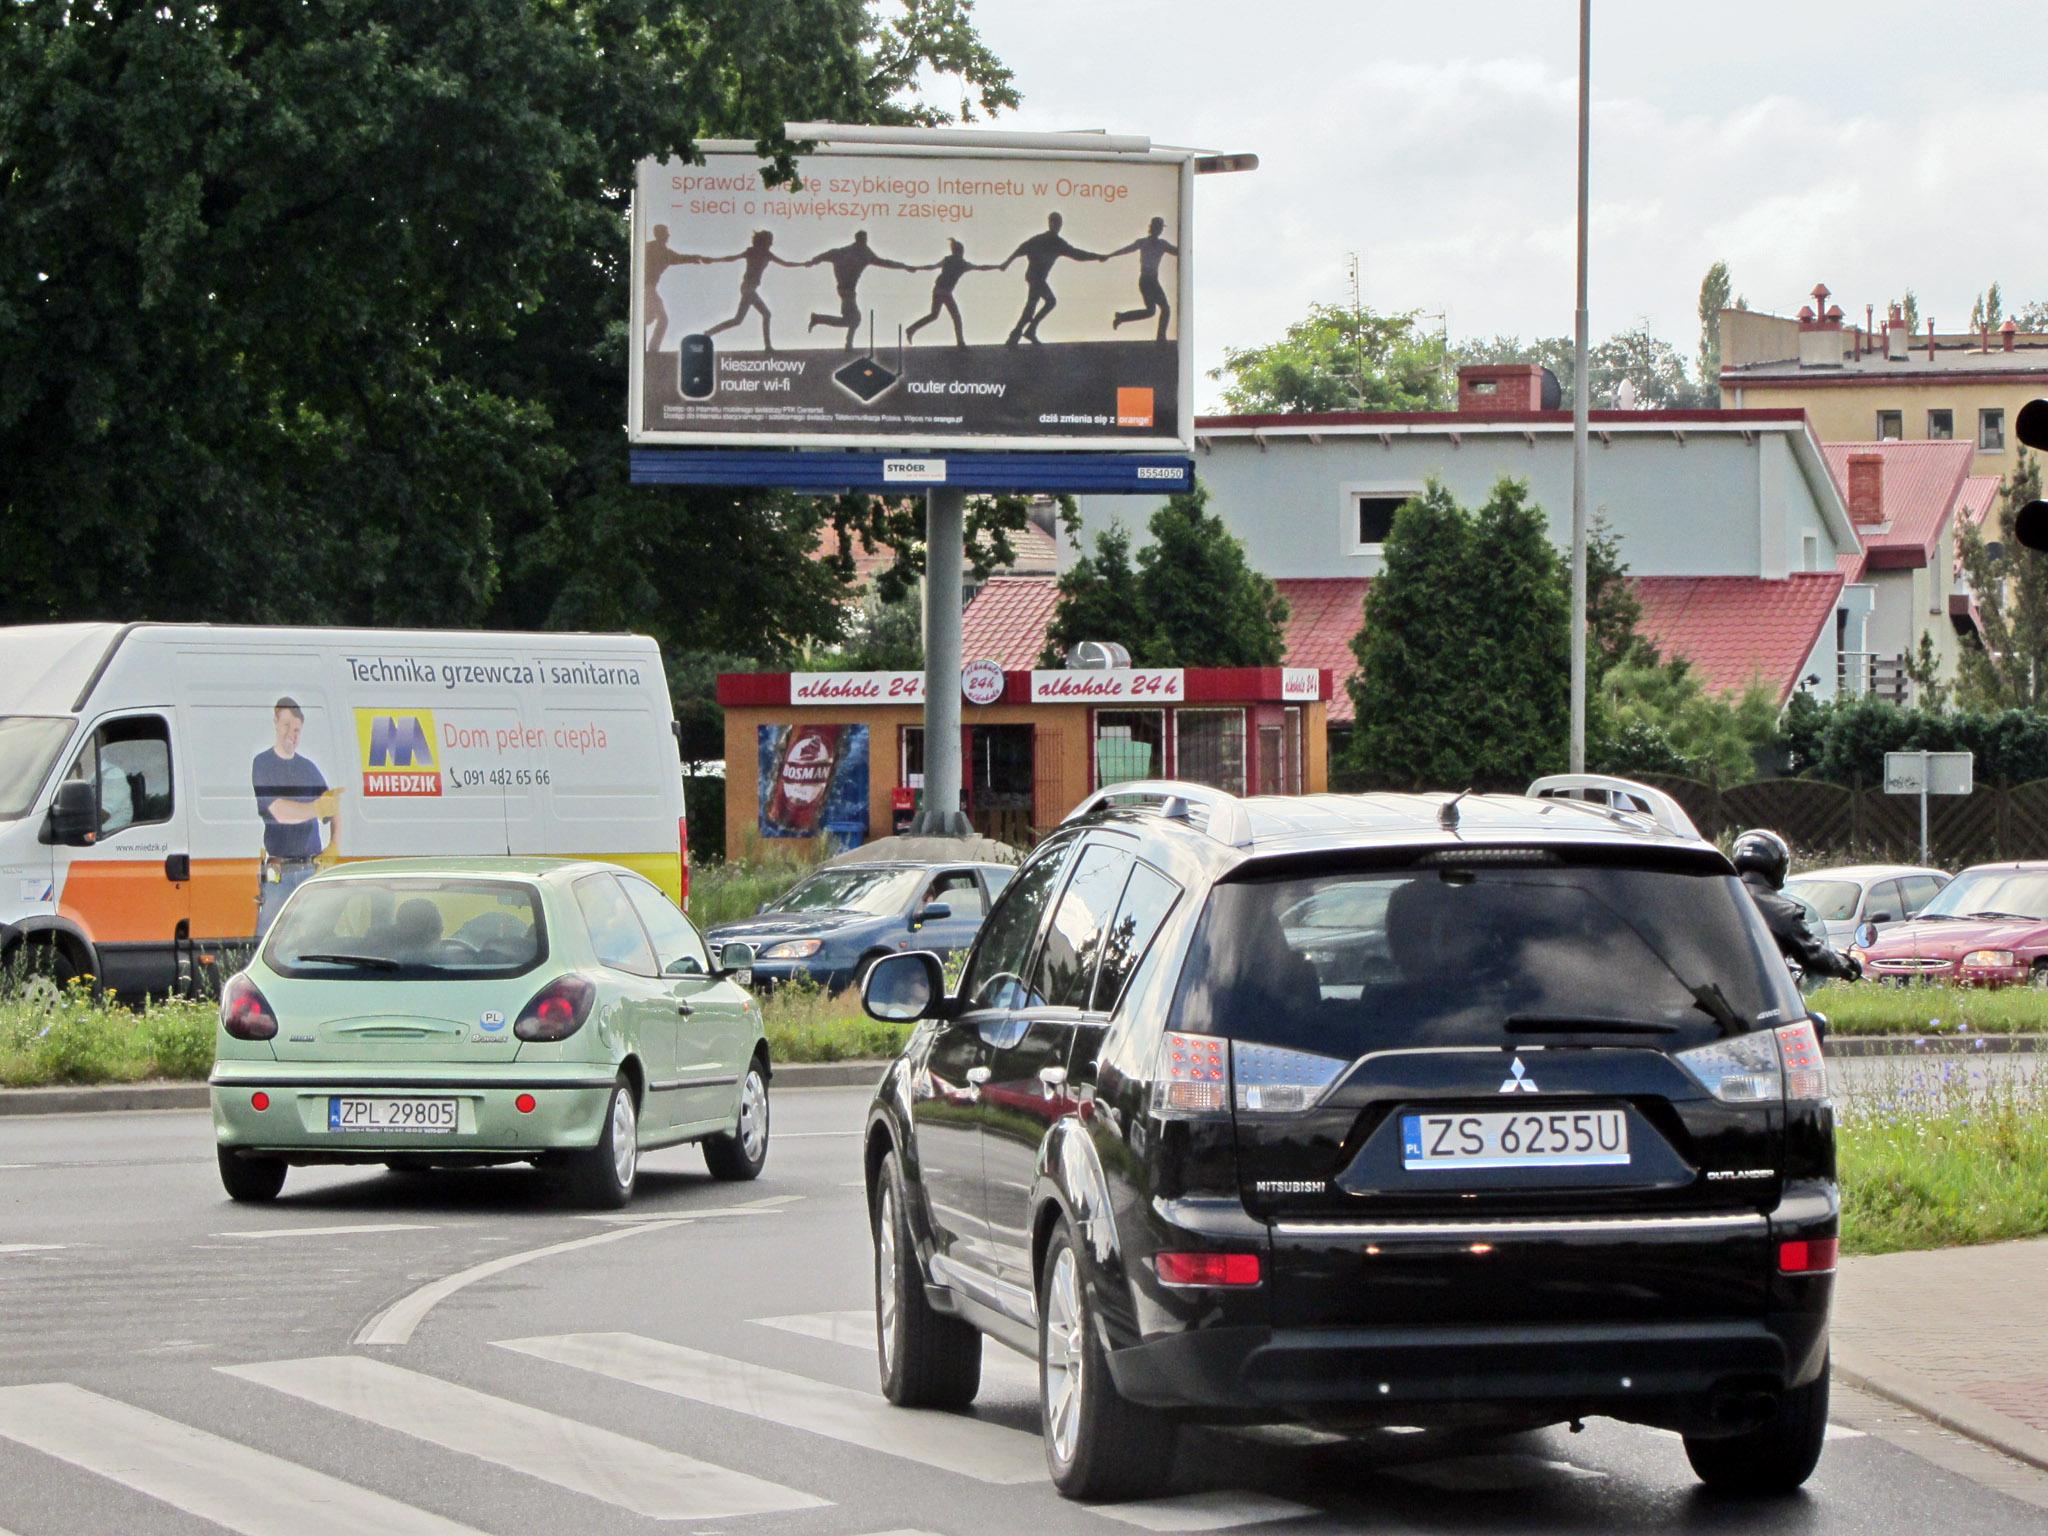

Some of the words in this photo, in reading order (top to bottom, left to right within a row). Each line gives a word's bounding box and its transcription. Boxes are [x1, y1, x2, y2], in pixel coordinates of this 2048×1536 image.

[672, 174, 756, 195] sprawdź
[829, 175, 930, 198] szybkiego
[938, 177, 1024, 196] Internetu
[1032, 182, 1048, 196] w
[1056, 178, 1128, 203] Orange
[690, 196, 735, 215] sieci
[744, 200, 755, 214] o
[763, 198, 889, 221] największym
[897, 201, 973, 223] zasięgu
[720, 357, 806, 375] kieszonkowy
[720, 378, 760, 392] router
[764, 377, 791, 392] wi-fi
[908, 380, 946, 394] router
[949, 380, 1006, 397] domowy
[1060, 414, 1092, 424] zmienia
[346, 657, 435, 682] Technika
[442, 664, 534, 689] grzewcza
[538, 660, 546, 684] i
[551, 661, 640, 685] sanitarna
[798, 678, 880, 698] alkohole
[1038, 676, 1122, 696] alkohole
[444, 723, 489, 749] Dom
[496, 721, 547, 755] pełen
[554, 721, 607, 755] ciepła
[368, 775, 437, 793] MIEDZIK
[464, 770, 485, 785] 091
[489, 770, 512, 785] 482
[516, 771, 532, 785] 65
[535, 771, 550, 786] 66
[486, 1013, 499, 1021] PL
[342, 1102, 380, 1124] ZPL
[389, 1103, 453, 1125] 29805
[1427, 1118, 1484, 1157] ZS
[1500, 1115, 1620, 1155] 6255U
[1406, 1144, 1420, 1154] PL
[1707, 1169, 1775, 1180] OUTLANDER
[1256, 1181, 1326, 1193] MITSUBISHI
